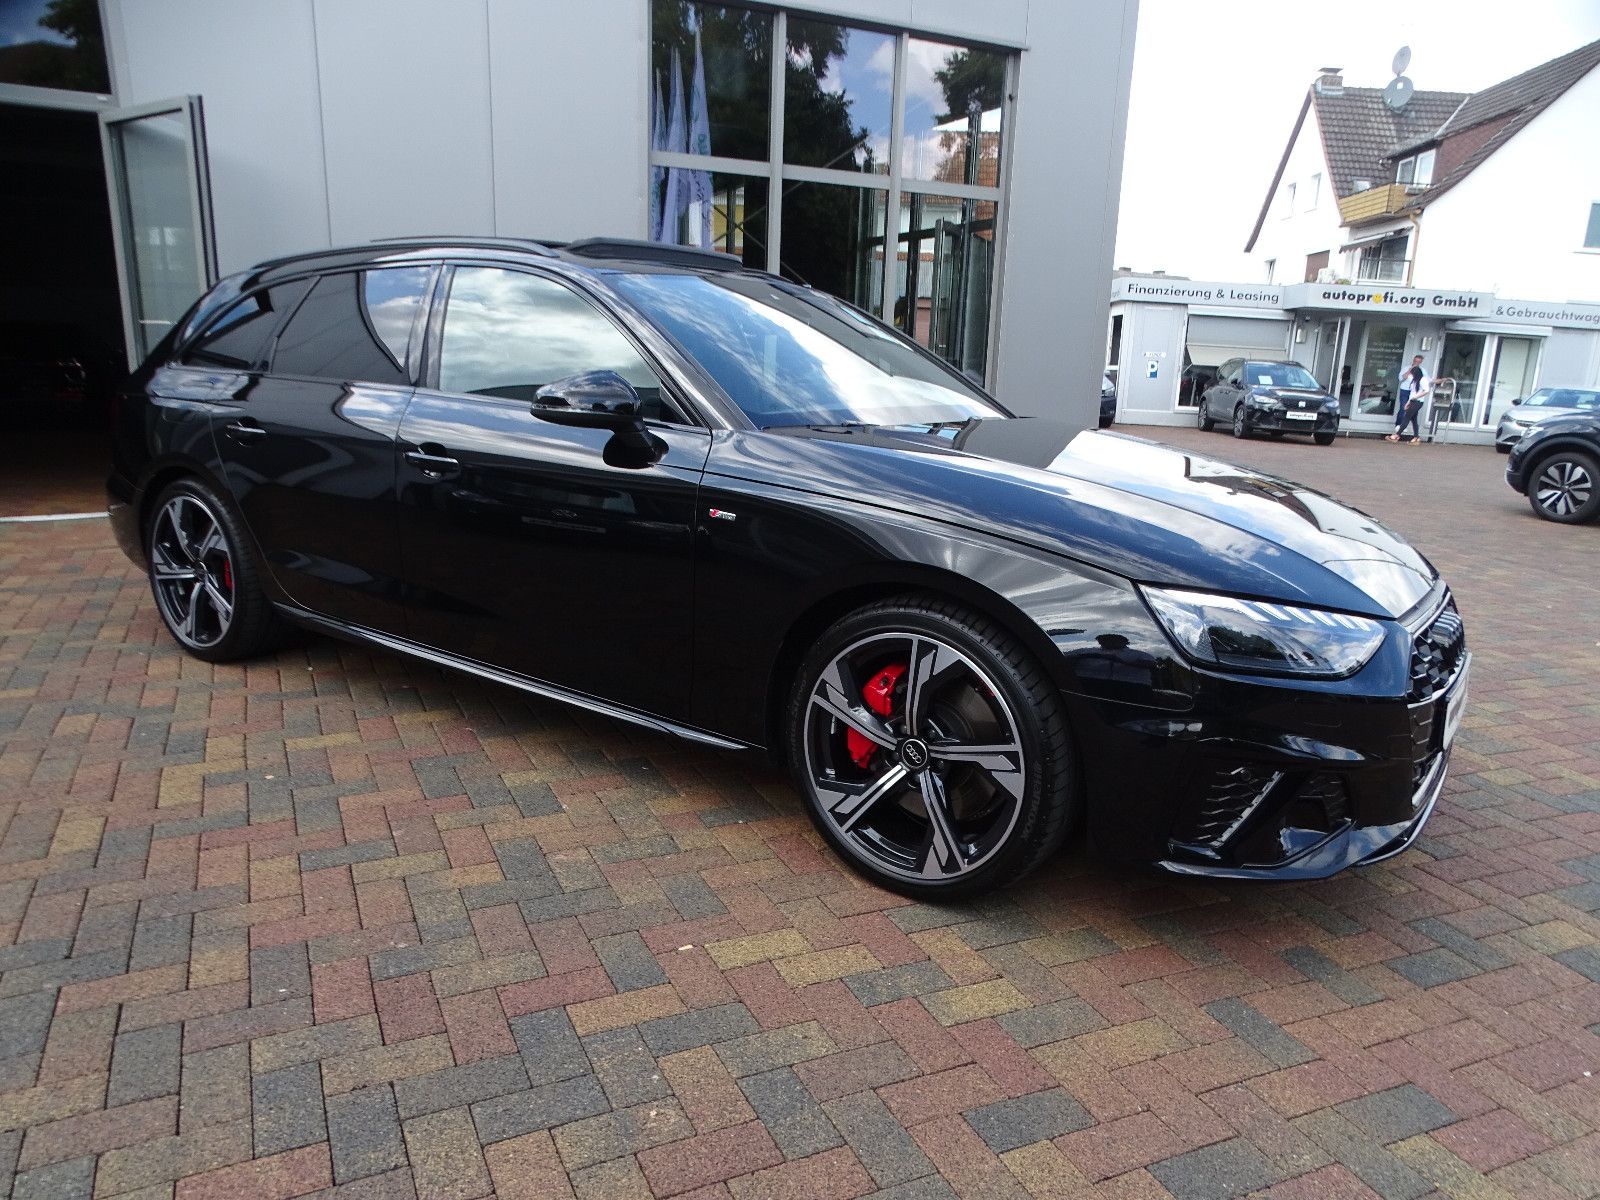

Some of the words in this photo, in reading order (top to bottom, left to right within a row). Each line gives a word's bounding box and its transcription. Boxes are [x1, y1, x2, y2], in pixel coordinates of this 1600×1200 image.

[1127, 283, 1211, 300] Finanzierung
[1216, 291, 1225, 299] &
[1230, 289, 1280, 304] Leasing
[1322, 290, 1426, 307] autoprofi.org
[1432, 295, 1479, 308] GmbH
[1495, 305, 1504, 316] &
